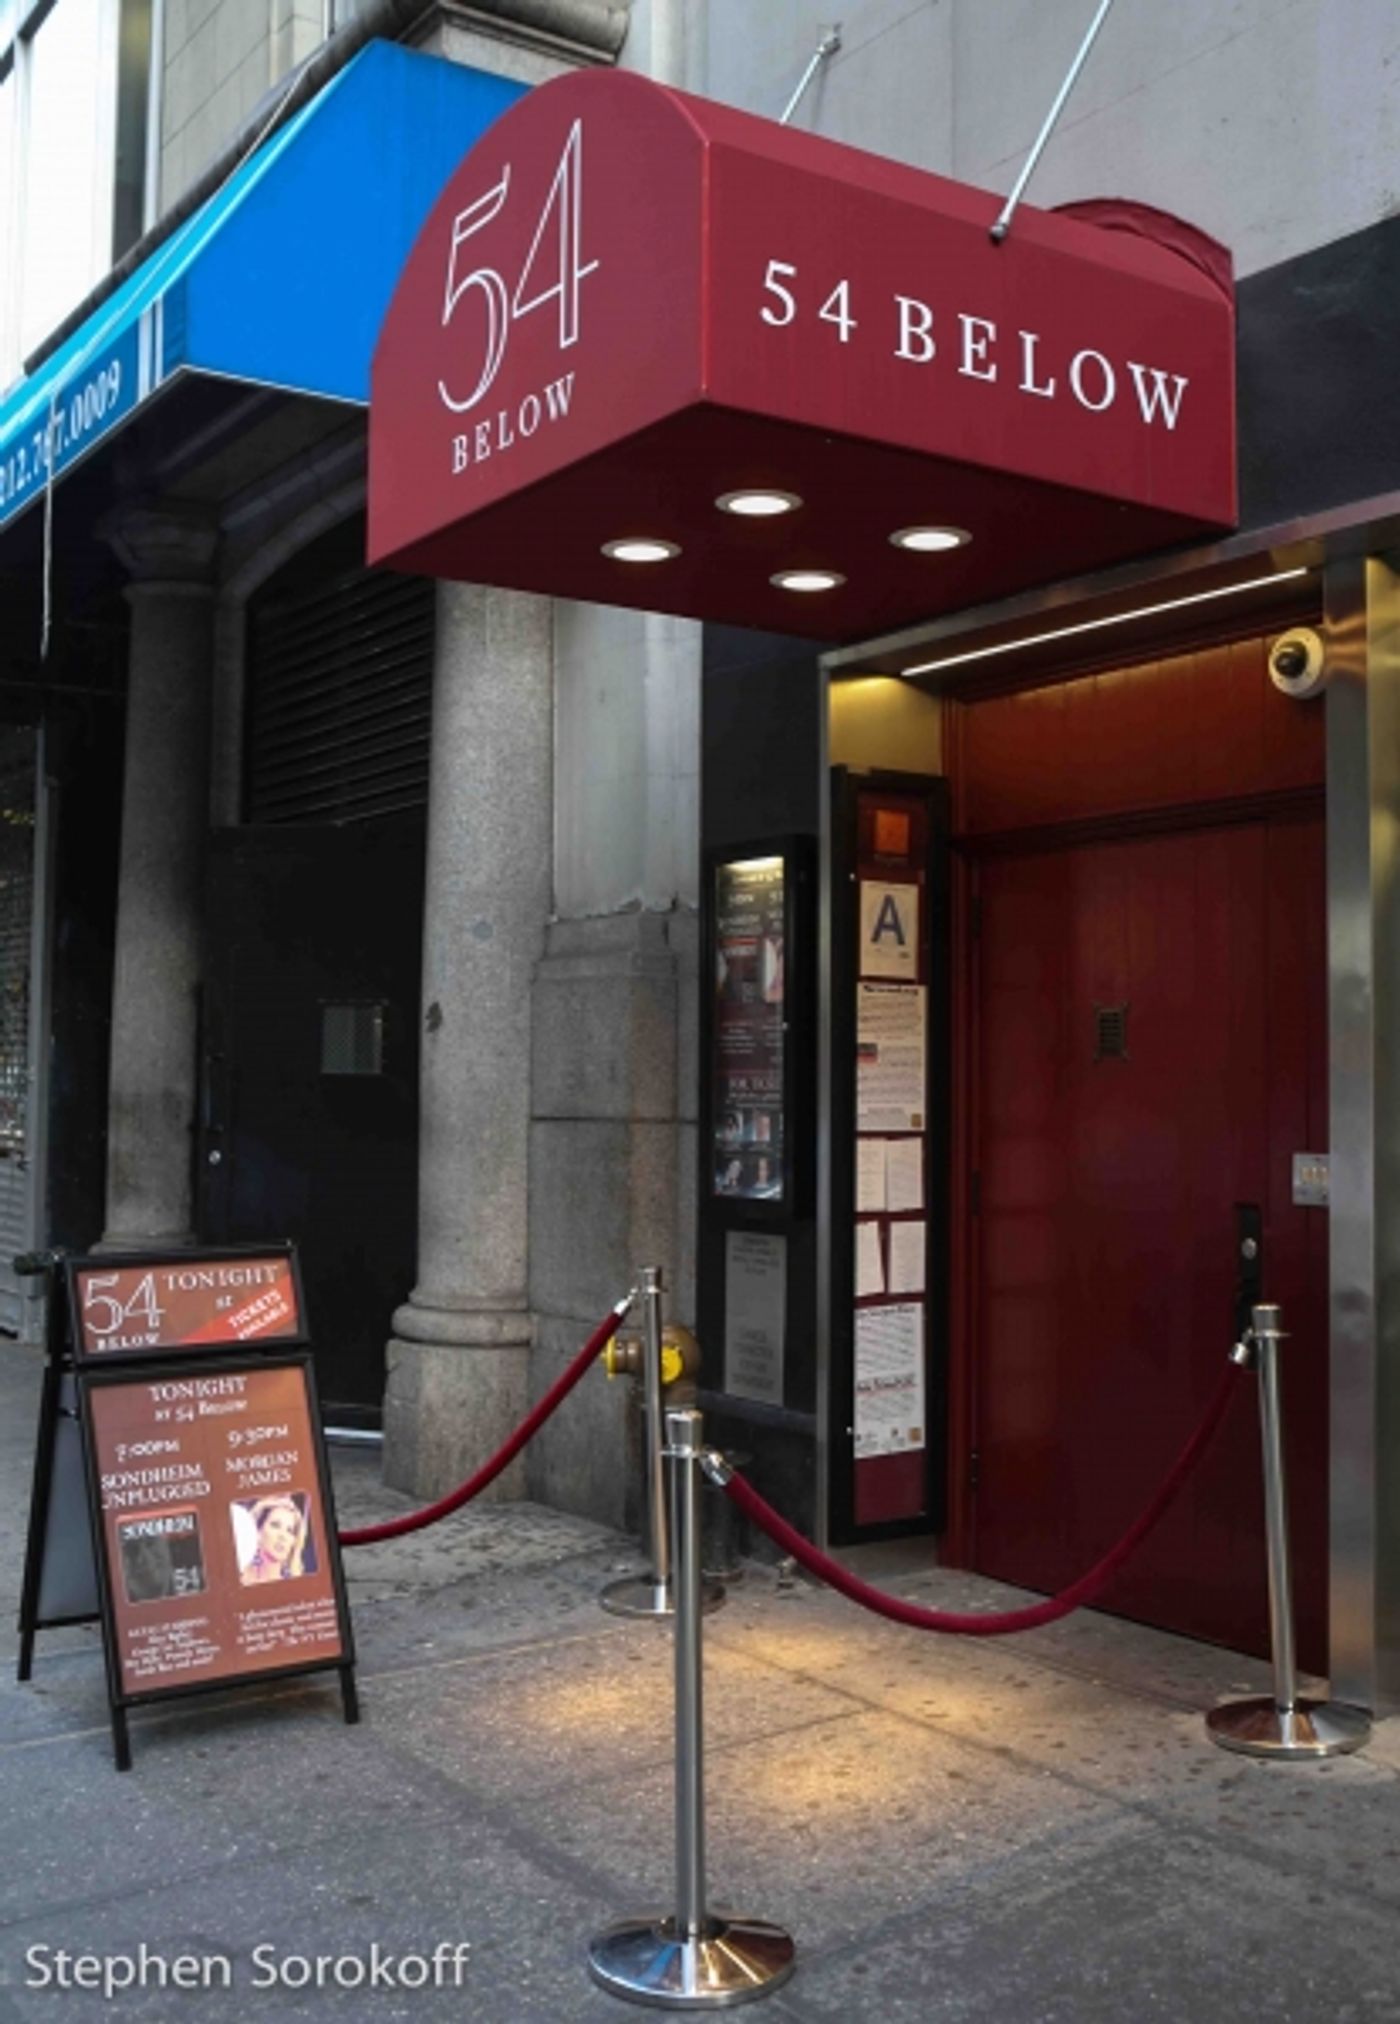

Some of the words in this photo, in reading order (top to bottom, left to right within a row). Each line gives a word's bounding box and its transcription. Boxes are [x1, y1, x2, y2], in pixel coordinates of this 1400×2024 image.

[438, 117, 600, 413] 54
[759, 259, 858, 343] 54
[893, 294, 1189, 431] BELOW
[451, 371, 576, 475] BELOW
[870, 893, 906, 946] A
[84, 1272, 166, 1335] 54
[163, 1265, 279, 1291] TONIGHT
[149, 1376, 248, 1403] TONIGHT
